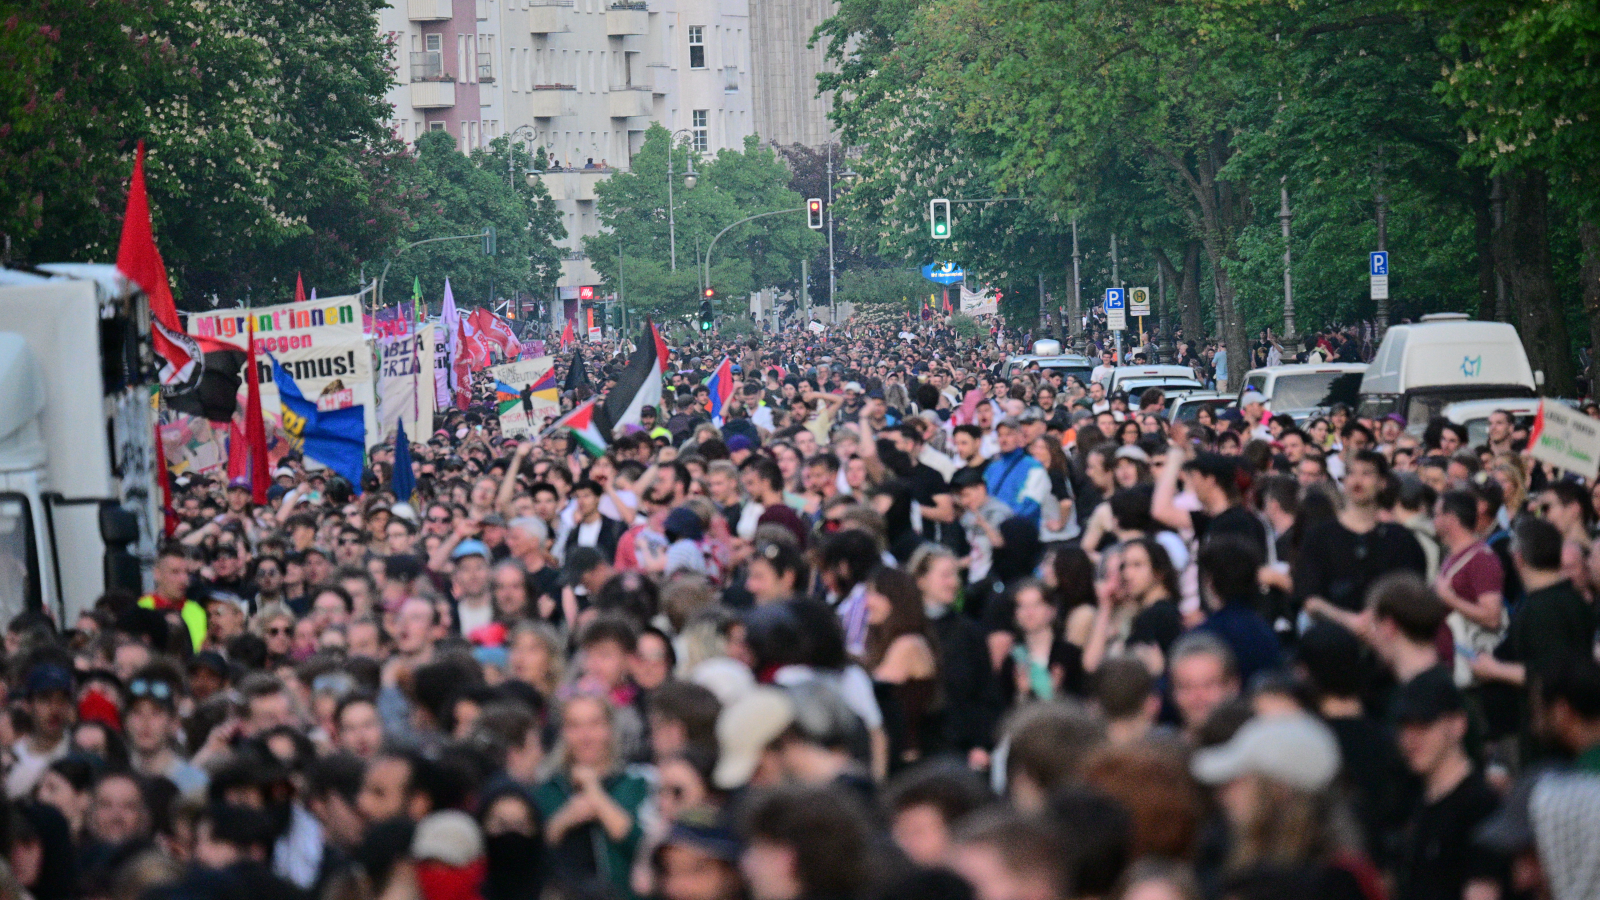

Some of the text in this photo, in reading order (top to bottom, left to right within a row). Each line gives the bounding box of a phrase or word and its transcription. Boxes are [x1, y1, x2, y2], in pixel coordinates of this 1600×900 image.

[1374, 255, 1384, 273] P
[1109, 291, 1119, 307] P
[1136, 291, 1143, 301] H
[253, 334, 313, 356] gegen
